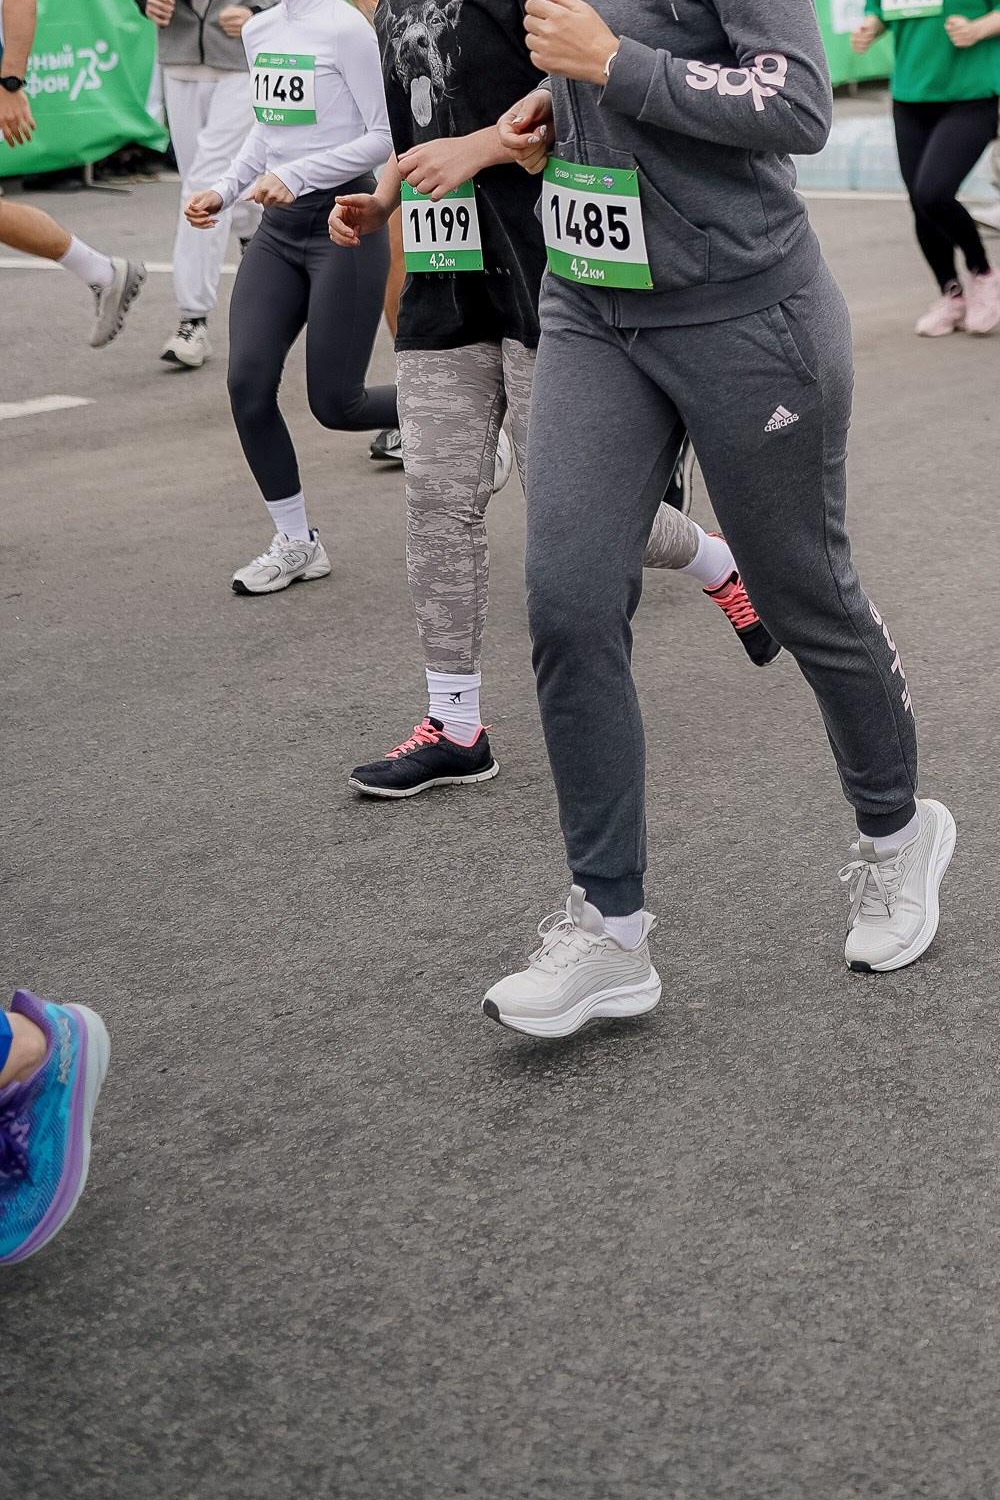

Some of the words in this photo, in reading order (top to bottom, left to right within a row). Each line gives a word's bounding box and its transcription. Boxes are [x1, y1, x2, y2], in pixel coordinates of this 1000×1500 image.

[254, 73, 305, 102] 1148
[409, 205, 471, 244] 1199
[550, 194, 631, 252] 1485
[764, 413, 799, 432] adidas
